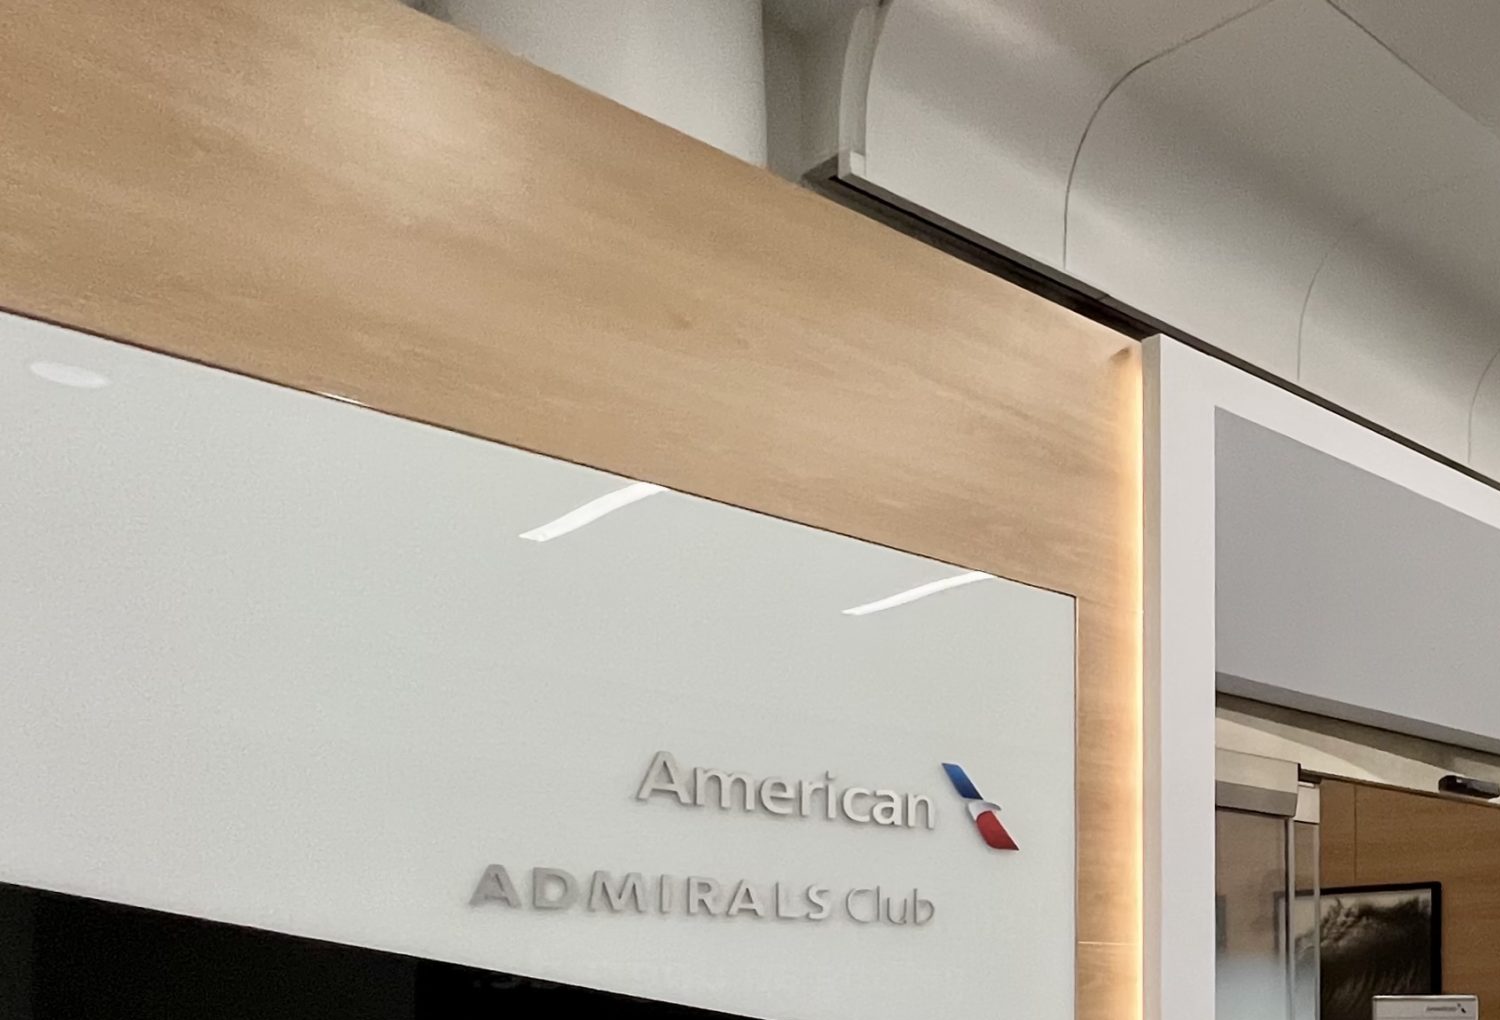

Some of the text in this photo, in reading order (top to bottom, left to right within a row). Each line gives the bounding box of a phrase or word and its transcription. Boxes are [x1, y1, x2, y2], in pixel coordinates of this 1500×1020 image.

[636, 750, 936, 829] American
[468, 863, 936, 926] ADMIRALS Club
